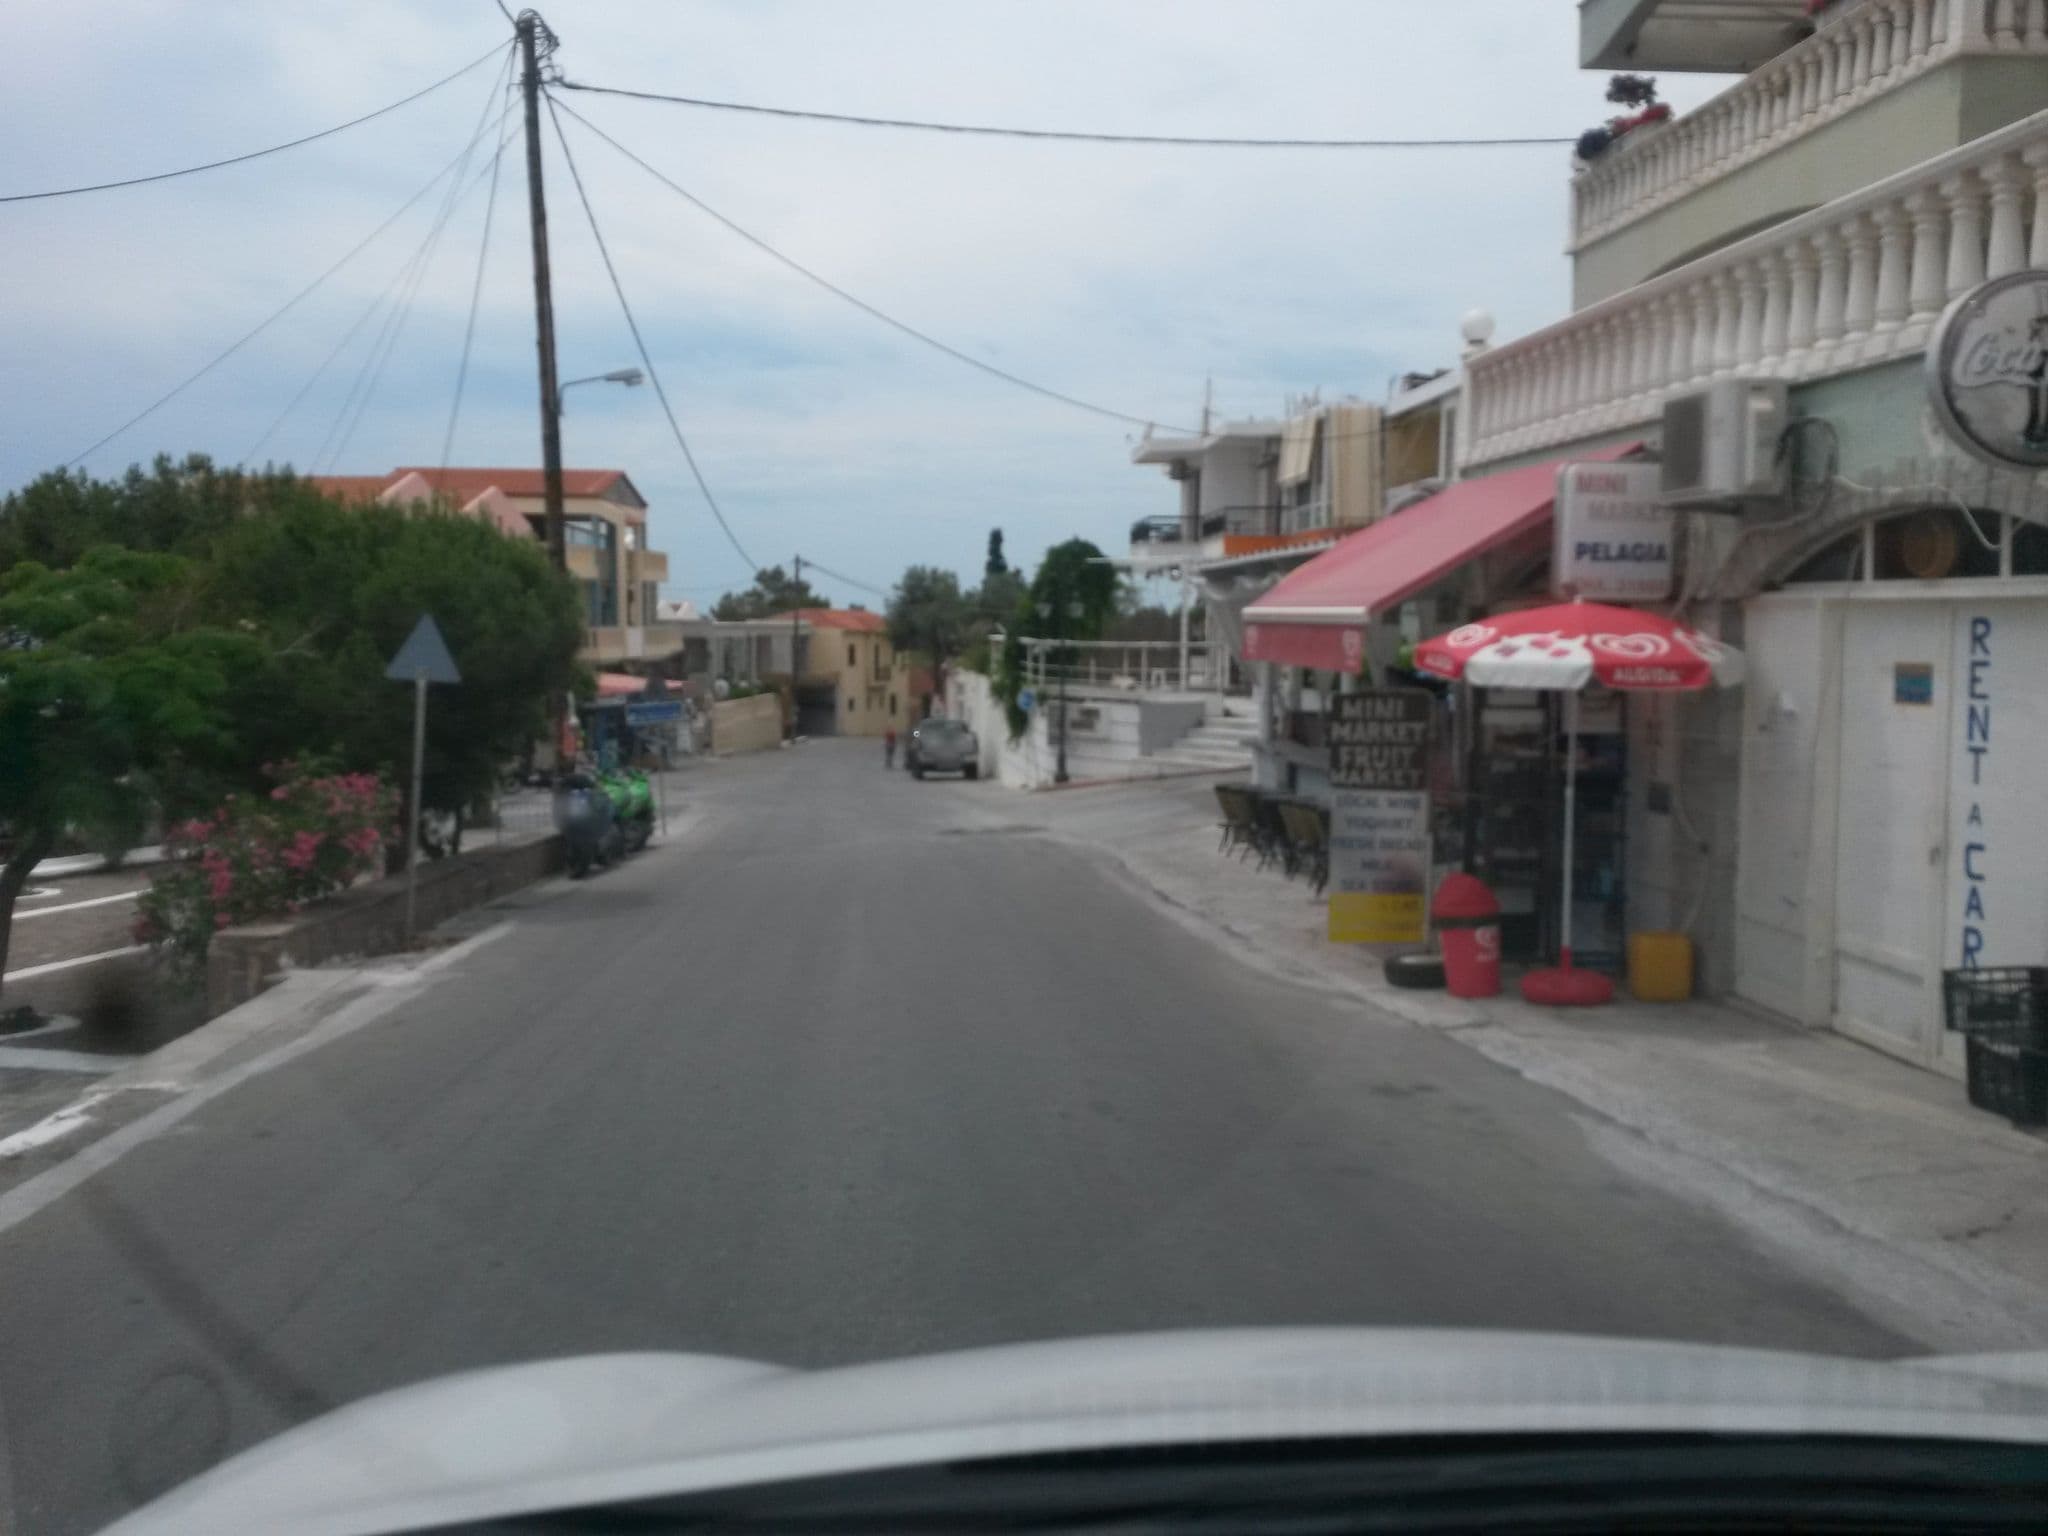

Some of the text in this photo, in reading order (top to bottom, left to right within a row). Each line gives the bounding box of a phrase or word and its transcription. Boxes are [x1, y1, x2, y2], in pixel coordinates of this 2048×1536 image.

[1575, 542, 1666, 562] PELAGIA
[1342, 698, 1404, 719] MINI
[1331, 721, 1424, 744] MARKET
[1340, 745, 1417, 768] FRUIT
[1331, 768, 1424, 787] MARKET
[1962, 617, 1991, 968] RENT A CAR
